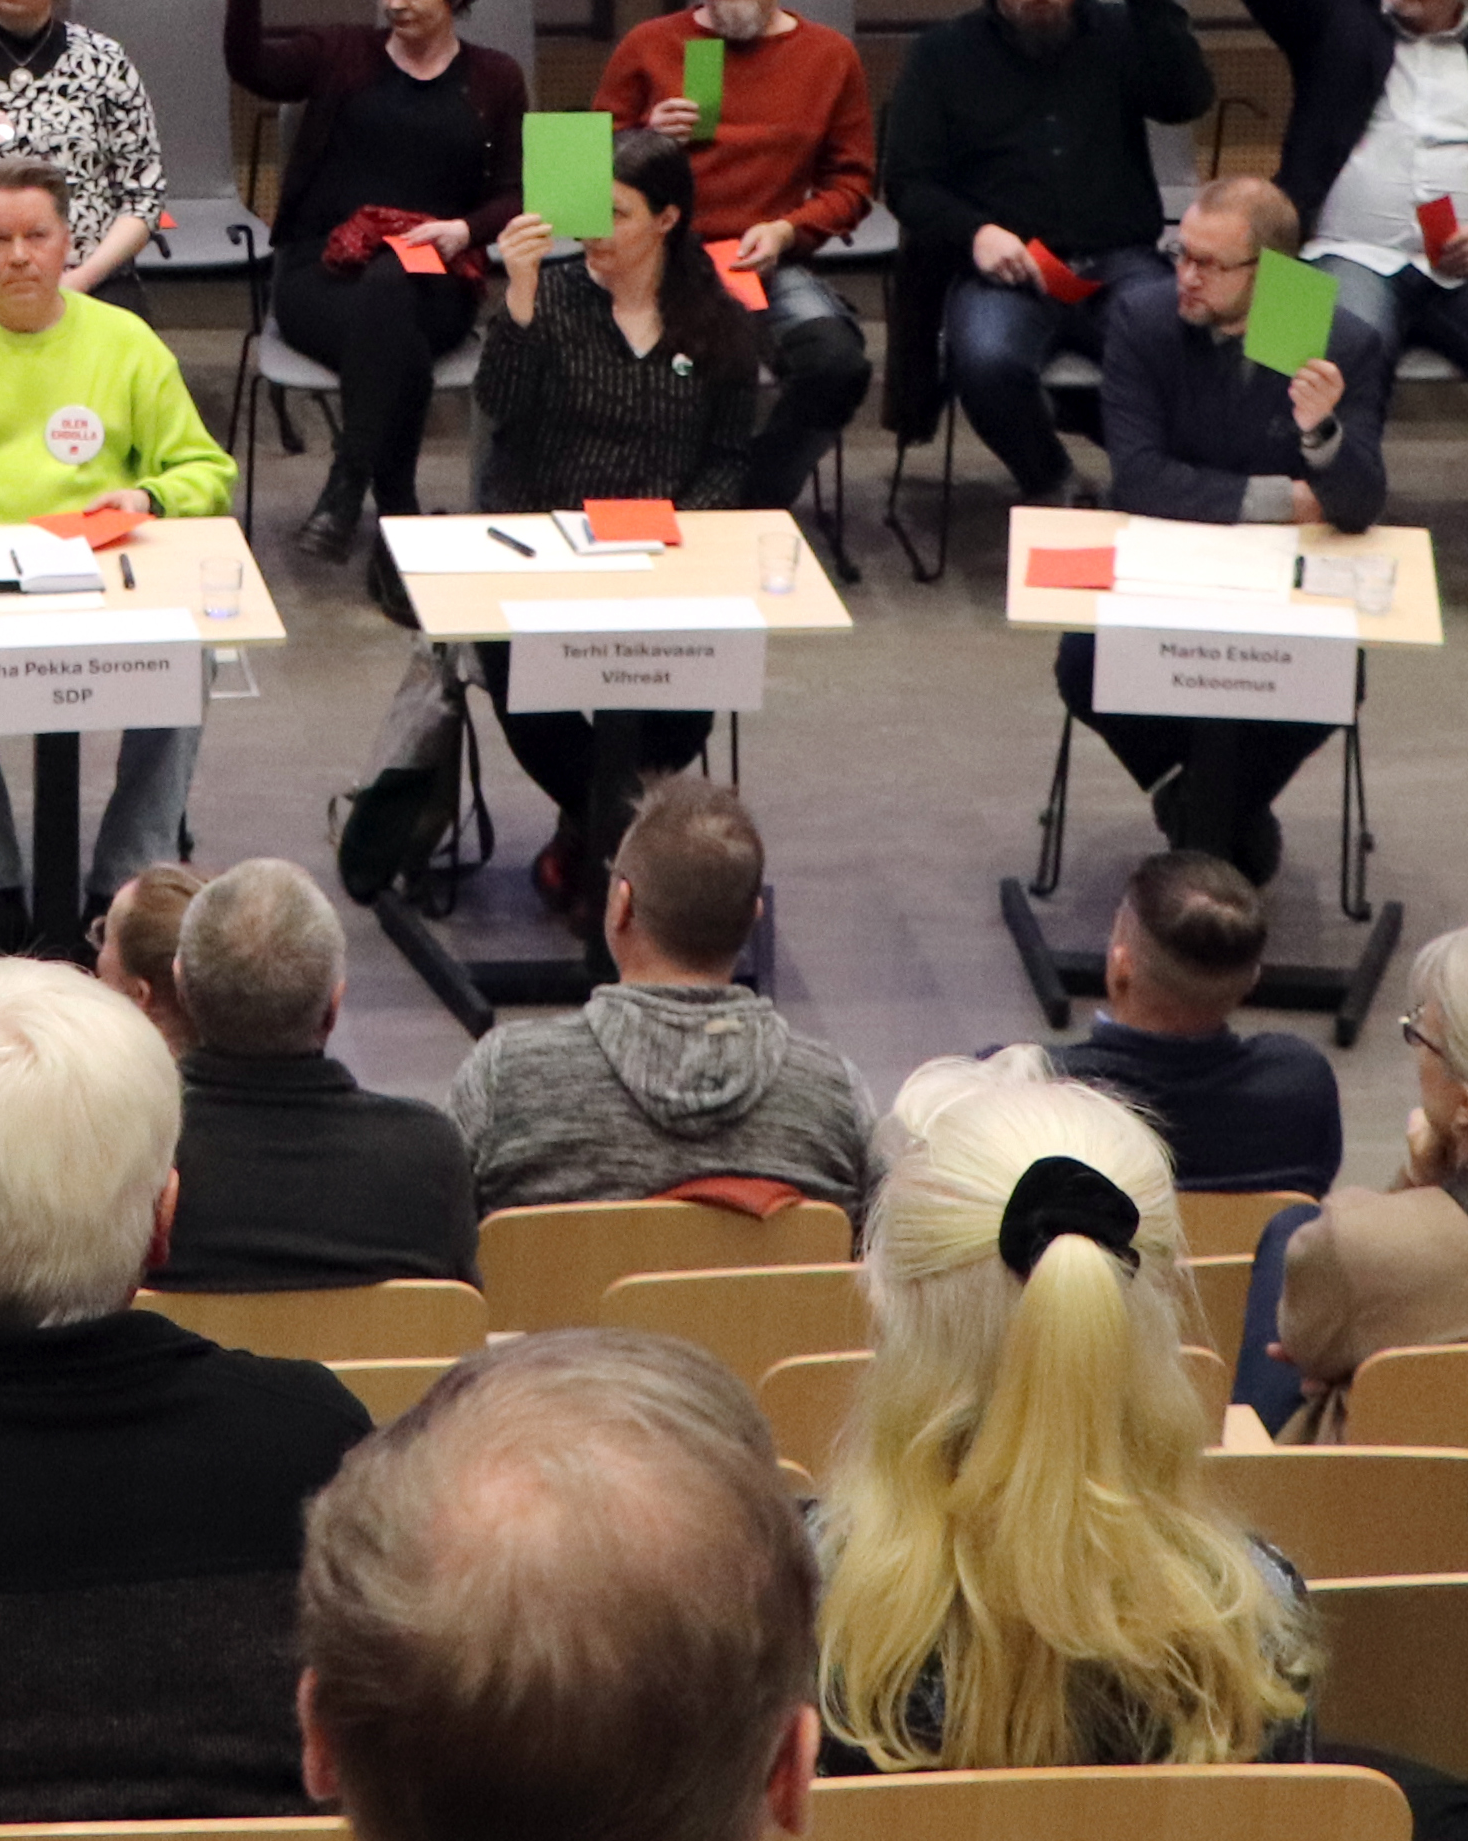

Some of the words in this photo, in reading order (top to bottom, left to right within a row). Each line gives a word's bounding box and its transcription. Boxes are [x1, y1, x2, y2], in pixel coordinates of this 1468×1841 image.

[1160, 643, 1222, 660] Marko
[1226, 645, 1292, 664] Eskola
[24, 659, 83, 677] Pekka
[88, 658, 171, 675] Soronen
[1172, 671, 1276, 693] Kokoomus
[52, 687, 93, 705] SDP
